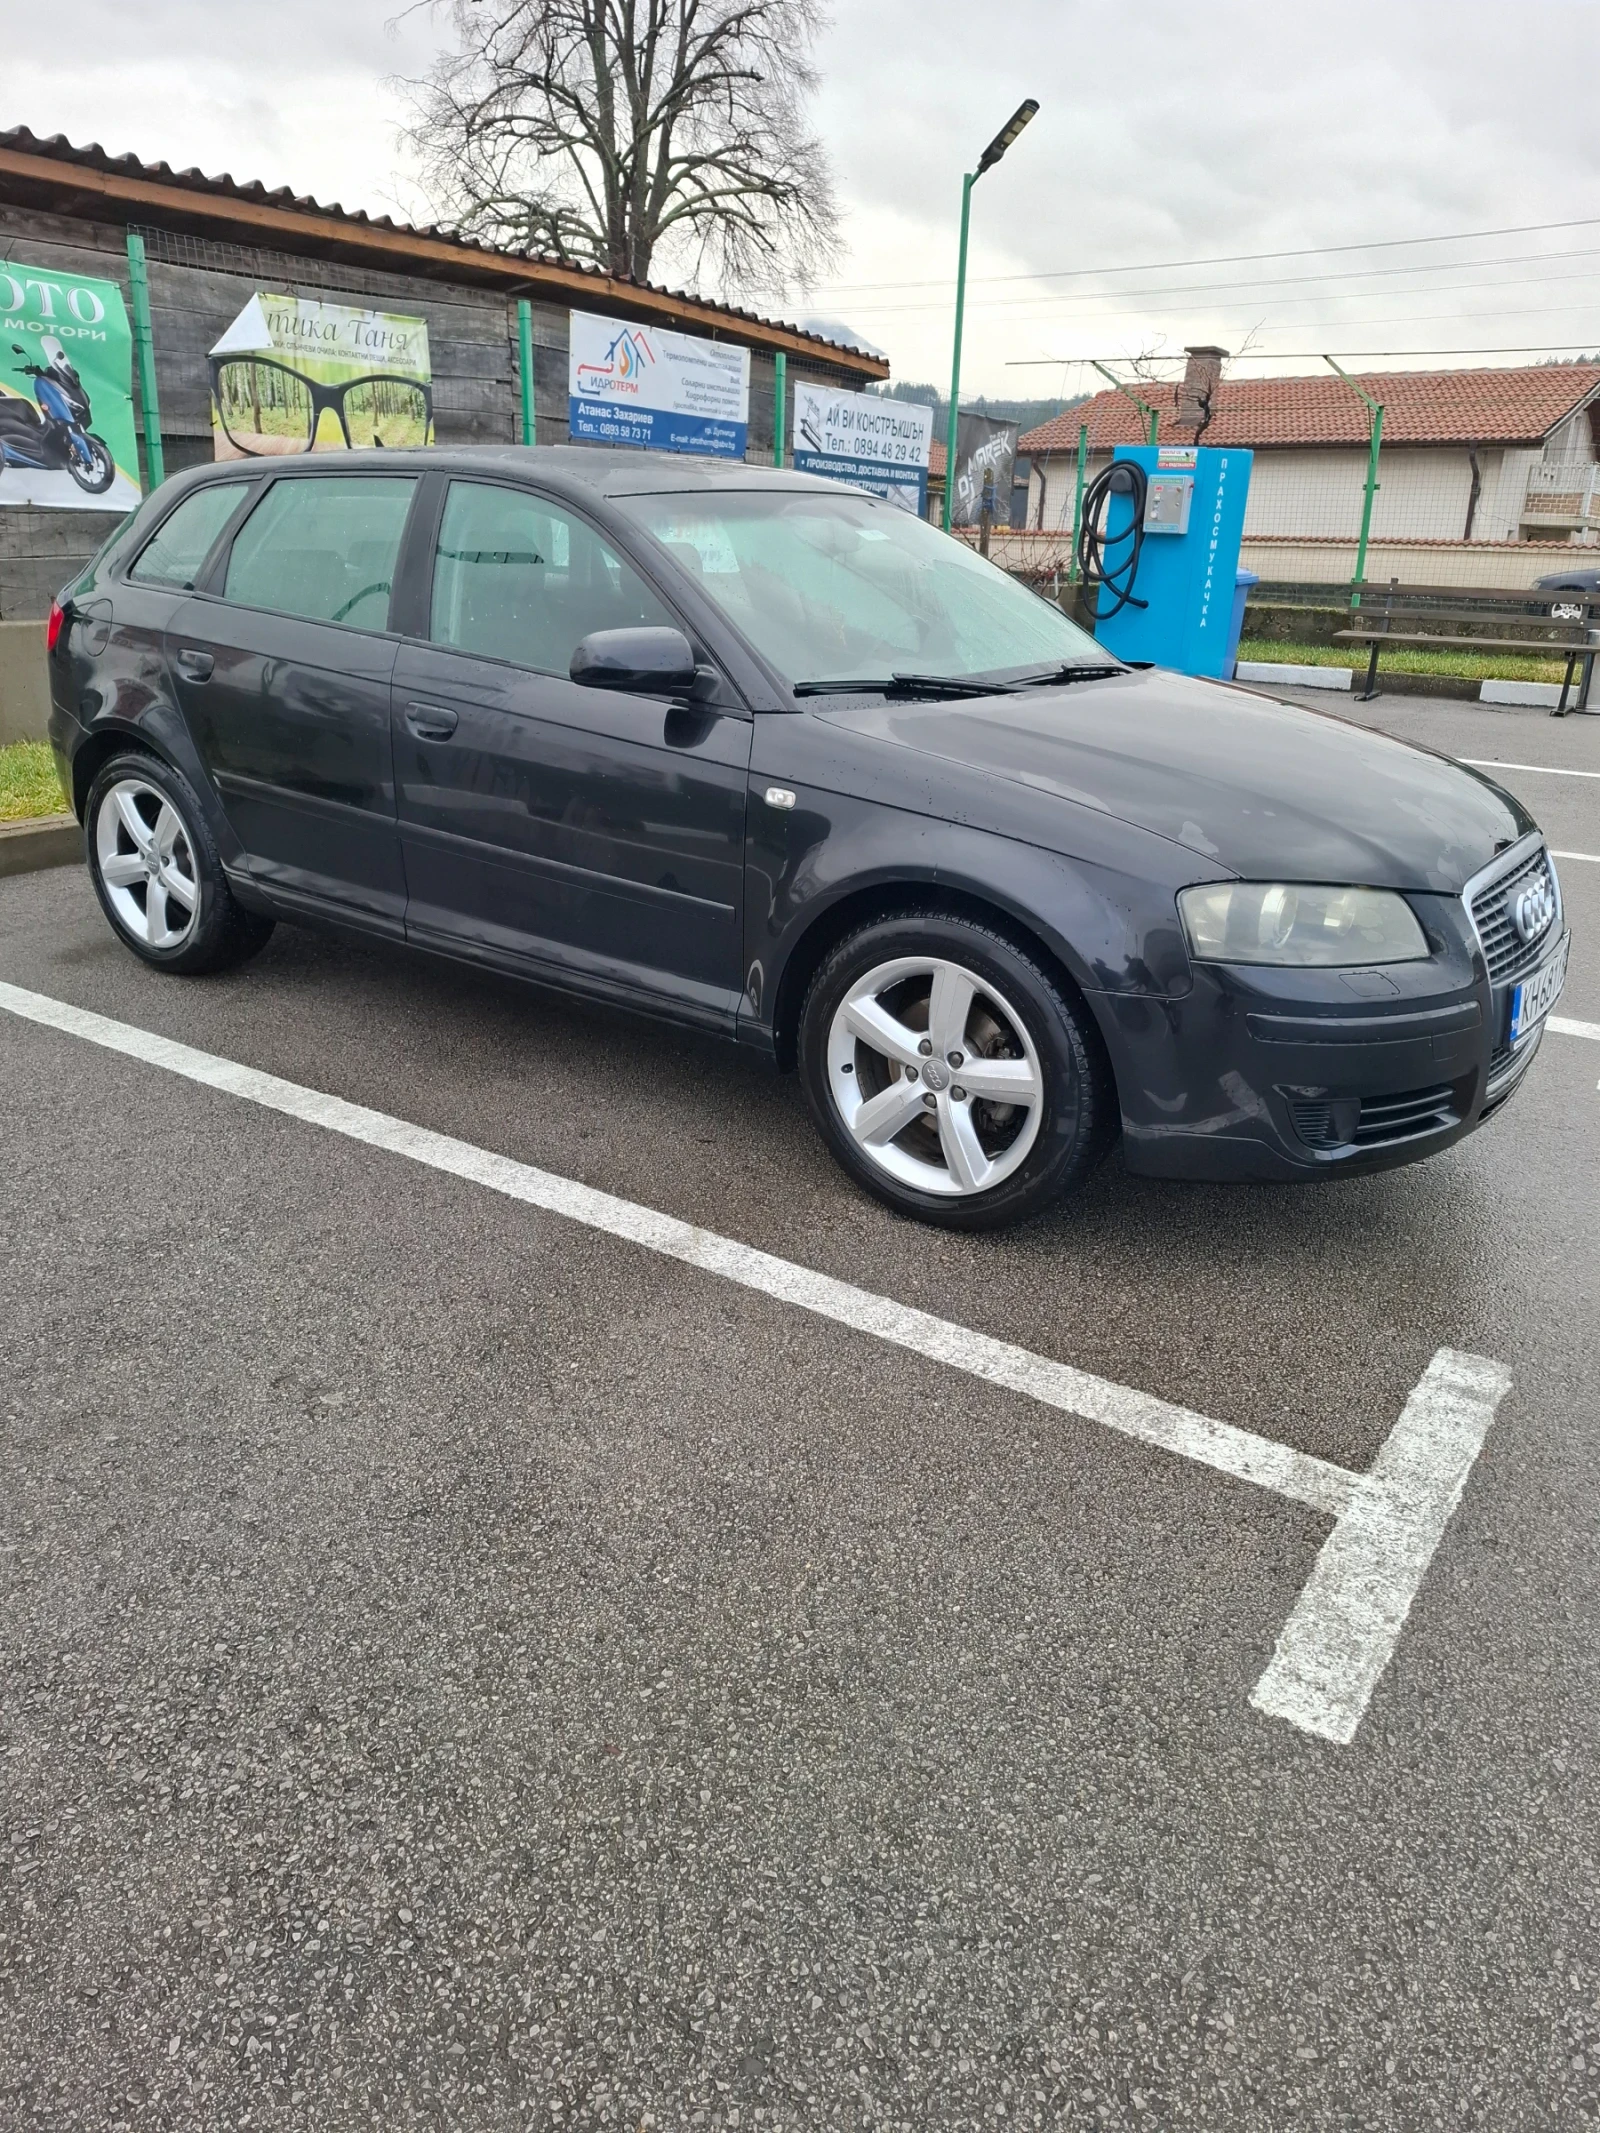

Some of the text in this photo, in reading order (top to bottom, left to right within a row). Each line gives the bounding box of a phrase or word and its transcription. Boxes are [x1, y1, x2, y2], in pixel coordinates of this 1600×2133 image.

[4, 317, 107, 342] МОТОРИ
[348, 319, 412, 351] Таня
[590, 376, 639, 394] ИДРОТЕРМ
[681, 377, 705, 391] Соларни
[577, 402, 654, 425] Атанас Захариев
[826, 403, 840, 427] АЙ
[843, 410, 855, 430] ВИ
[856, 412, 925, 442] КОНСТРЪКШЪН
[600, 422, 620, 436] 0893
[620, 425, 631, 438] 58
[631, 426, 641, 439] 73
[642, 428, 651, 440] 71
[825, 432, 921, 463] Тел.: 0894 48 29 42
[858, 464, 890, 478] ДОСТАВКА
[1200, 458, 1228, 628] ПРАХОСМУКАЧКА
